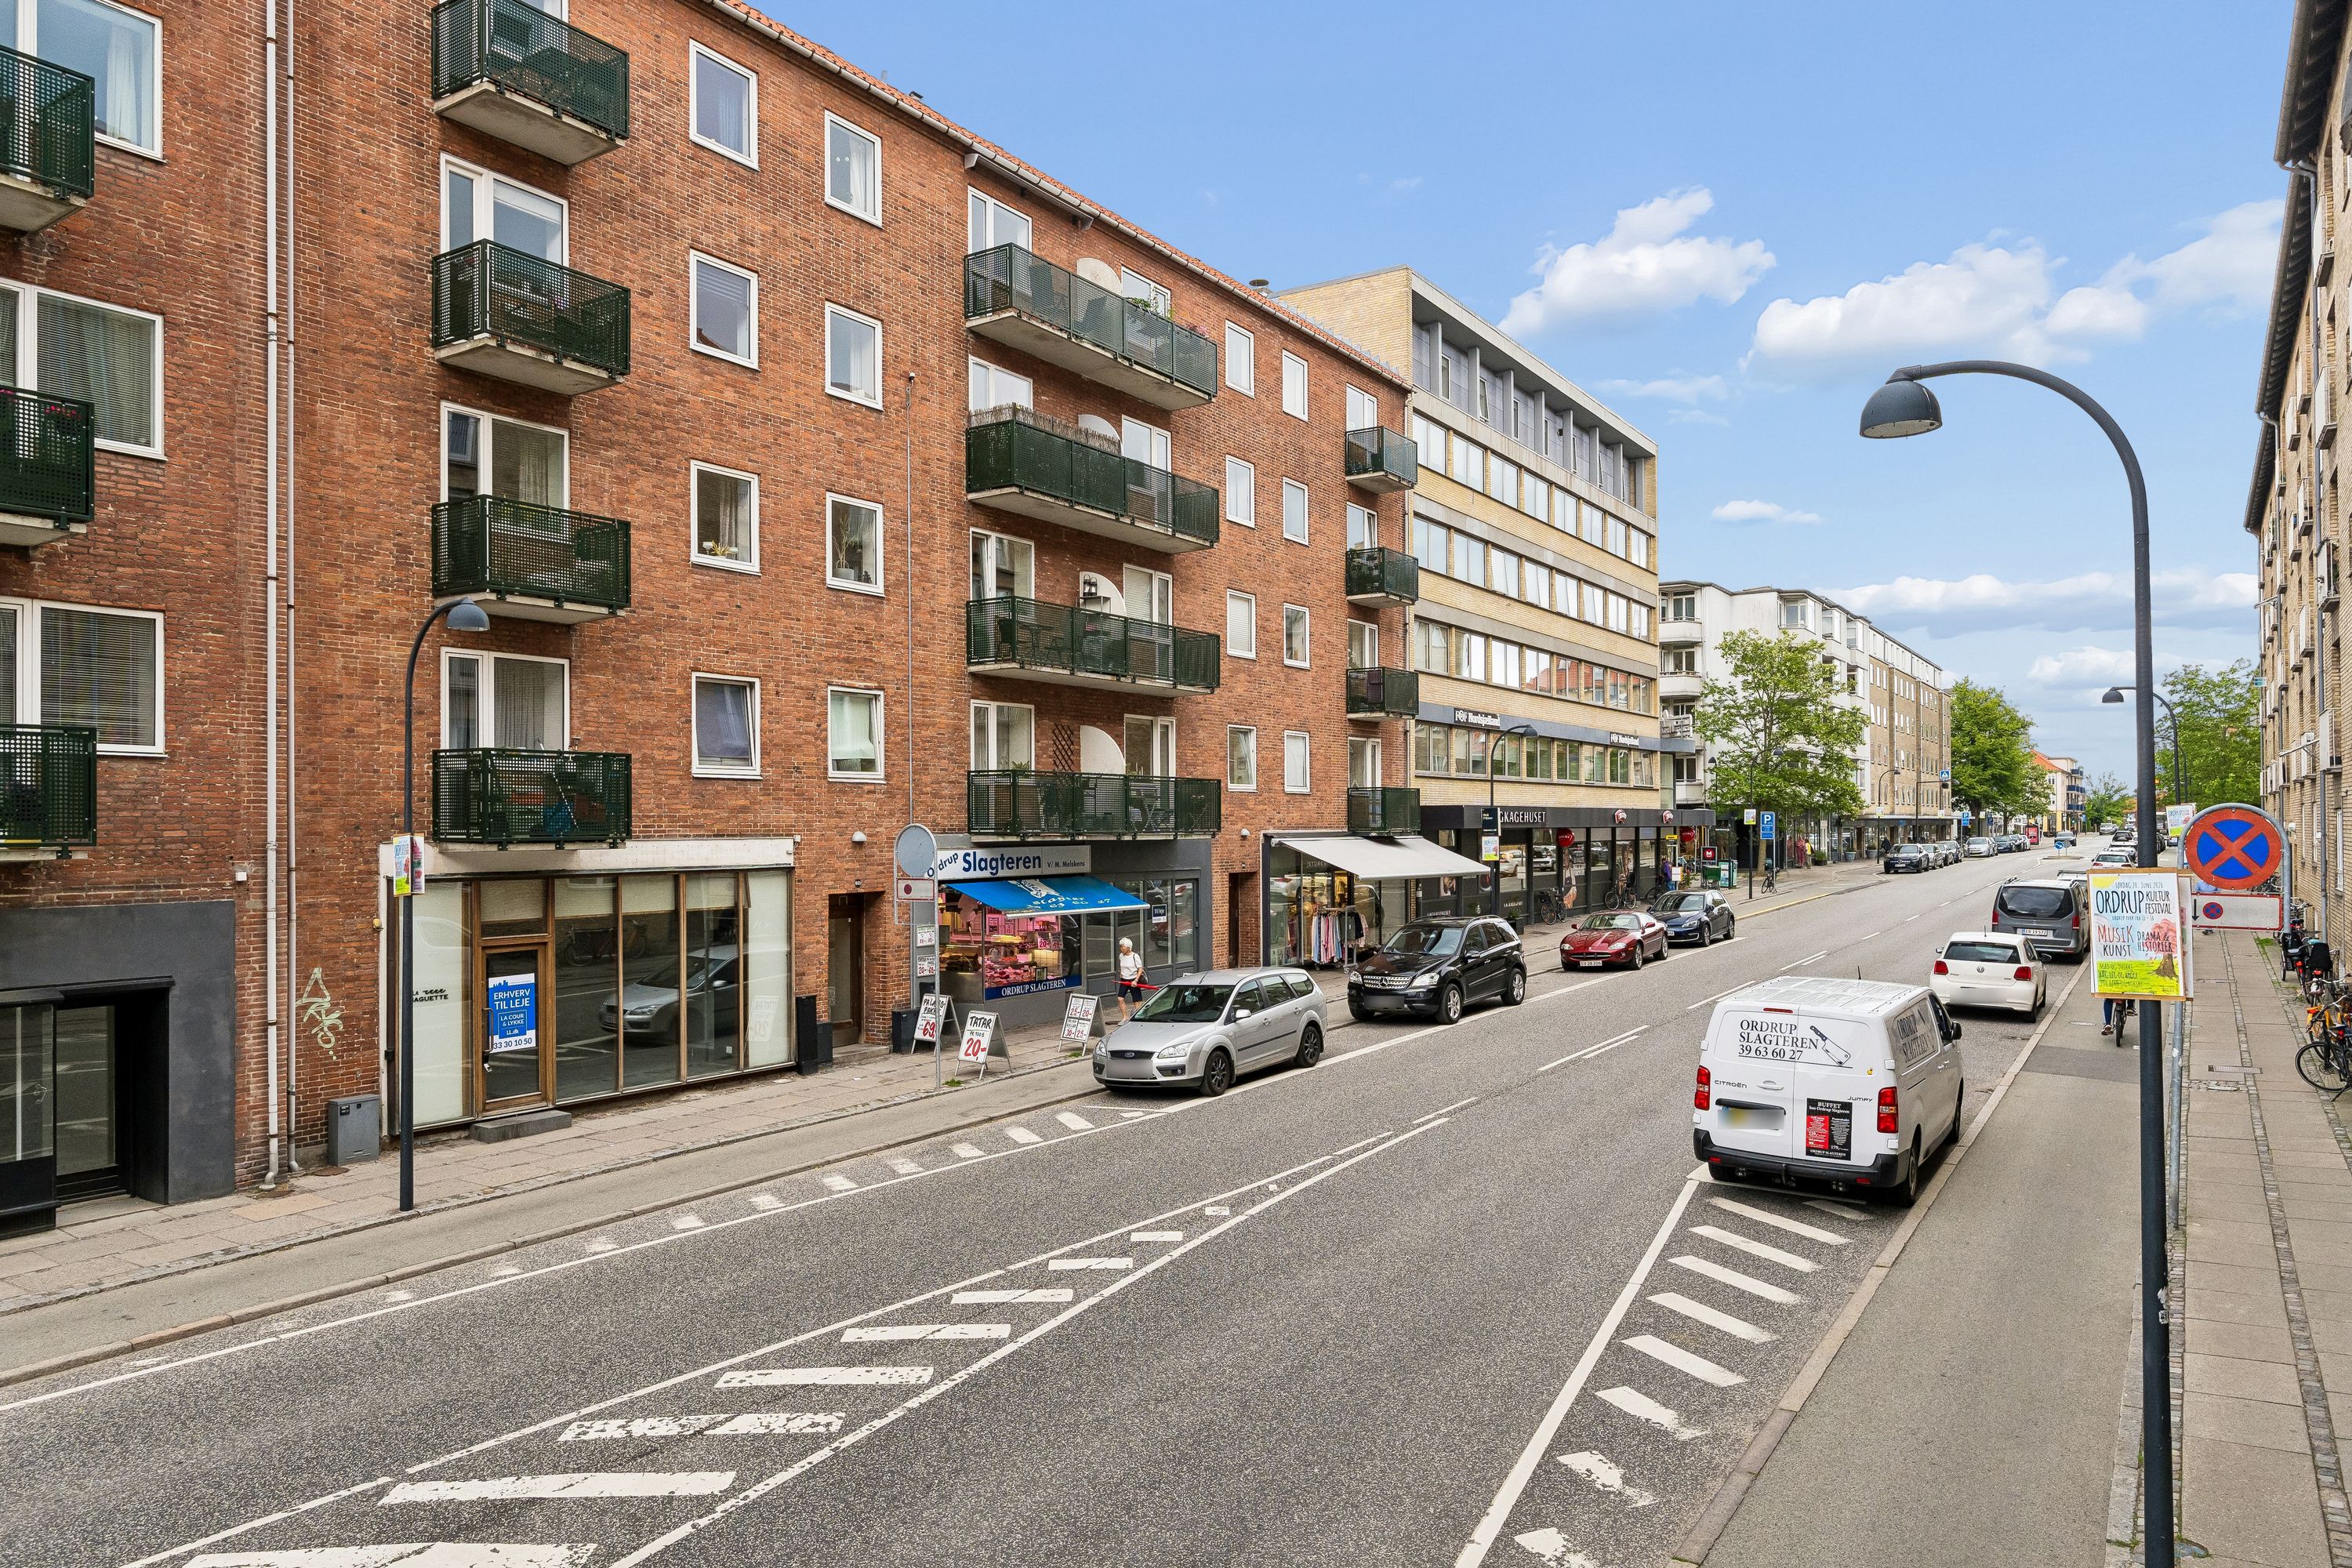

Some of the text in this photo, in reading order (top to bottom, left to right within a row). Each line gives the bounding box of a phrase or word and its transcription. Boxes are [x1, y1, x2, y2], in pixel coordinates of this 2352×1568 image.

[1499, 811, 1546, 822] GKAGEHUSET
[1764, 814, 1771, 824] P
[927, 851, 1042, 878] Odrup Slagteren
[2096, 890, 2170, 914] ORDRUP KULTUR
[2145, 902, 2172, 914] FESTIVAL
[2097, 925, 2133, 943] MUSIK
[2136, 931, 2169, 942] DRAMA &
[2103, 944, 2131, 956] KUNST
[1001, 978, 1066, 996] ORDRUP SLAGTEREN
[412, 993, 448, 1003] AGUETTE
[493, 989, 531, 1000] ERHVERV
[494, 997, 530, 1010] TIL LEJE
[969, 1015, 993, 1029] TATAR
[1740, 1019, 1797, 1035] ORDRUP
[1897, 1014, 1918, 1040] ORDRUP
[503, 1040, 513, 1048] 30
[1739, 1032, 1819, 1050] SLAGTEREN
[1902, 1033, 1929, 1063] SLAGTEREN
[1738, 1044, 1803, 1061] 39 63 60 27
